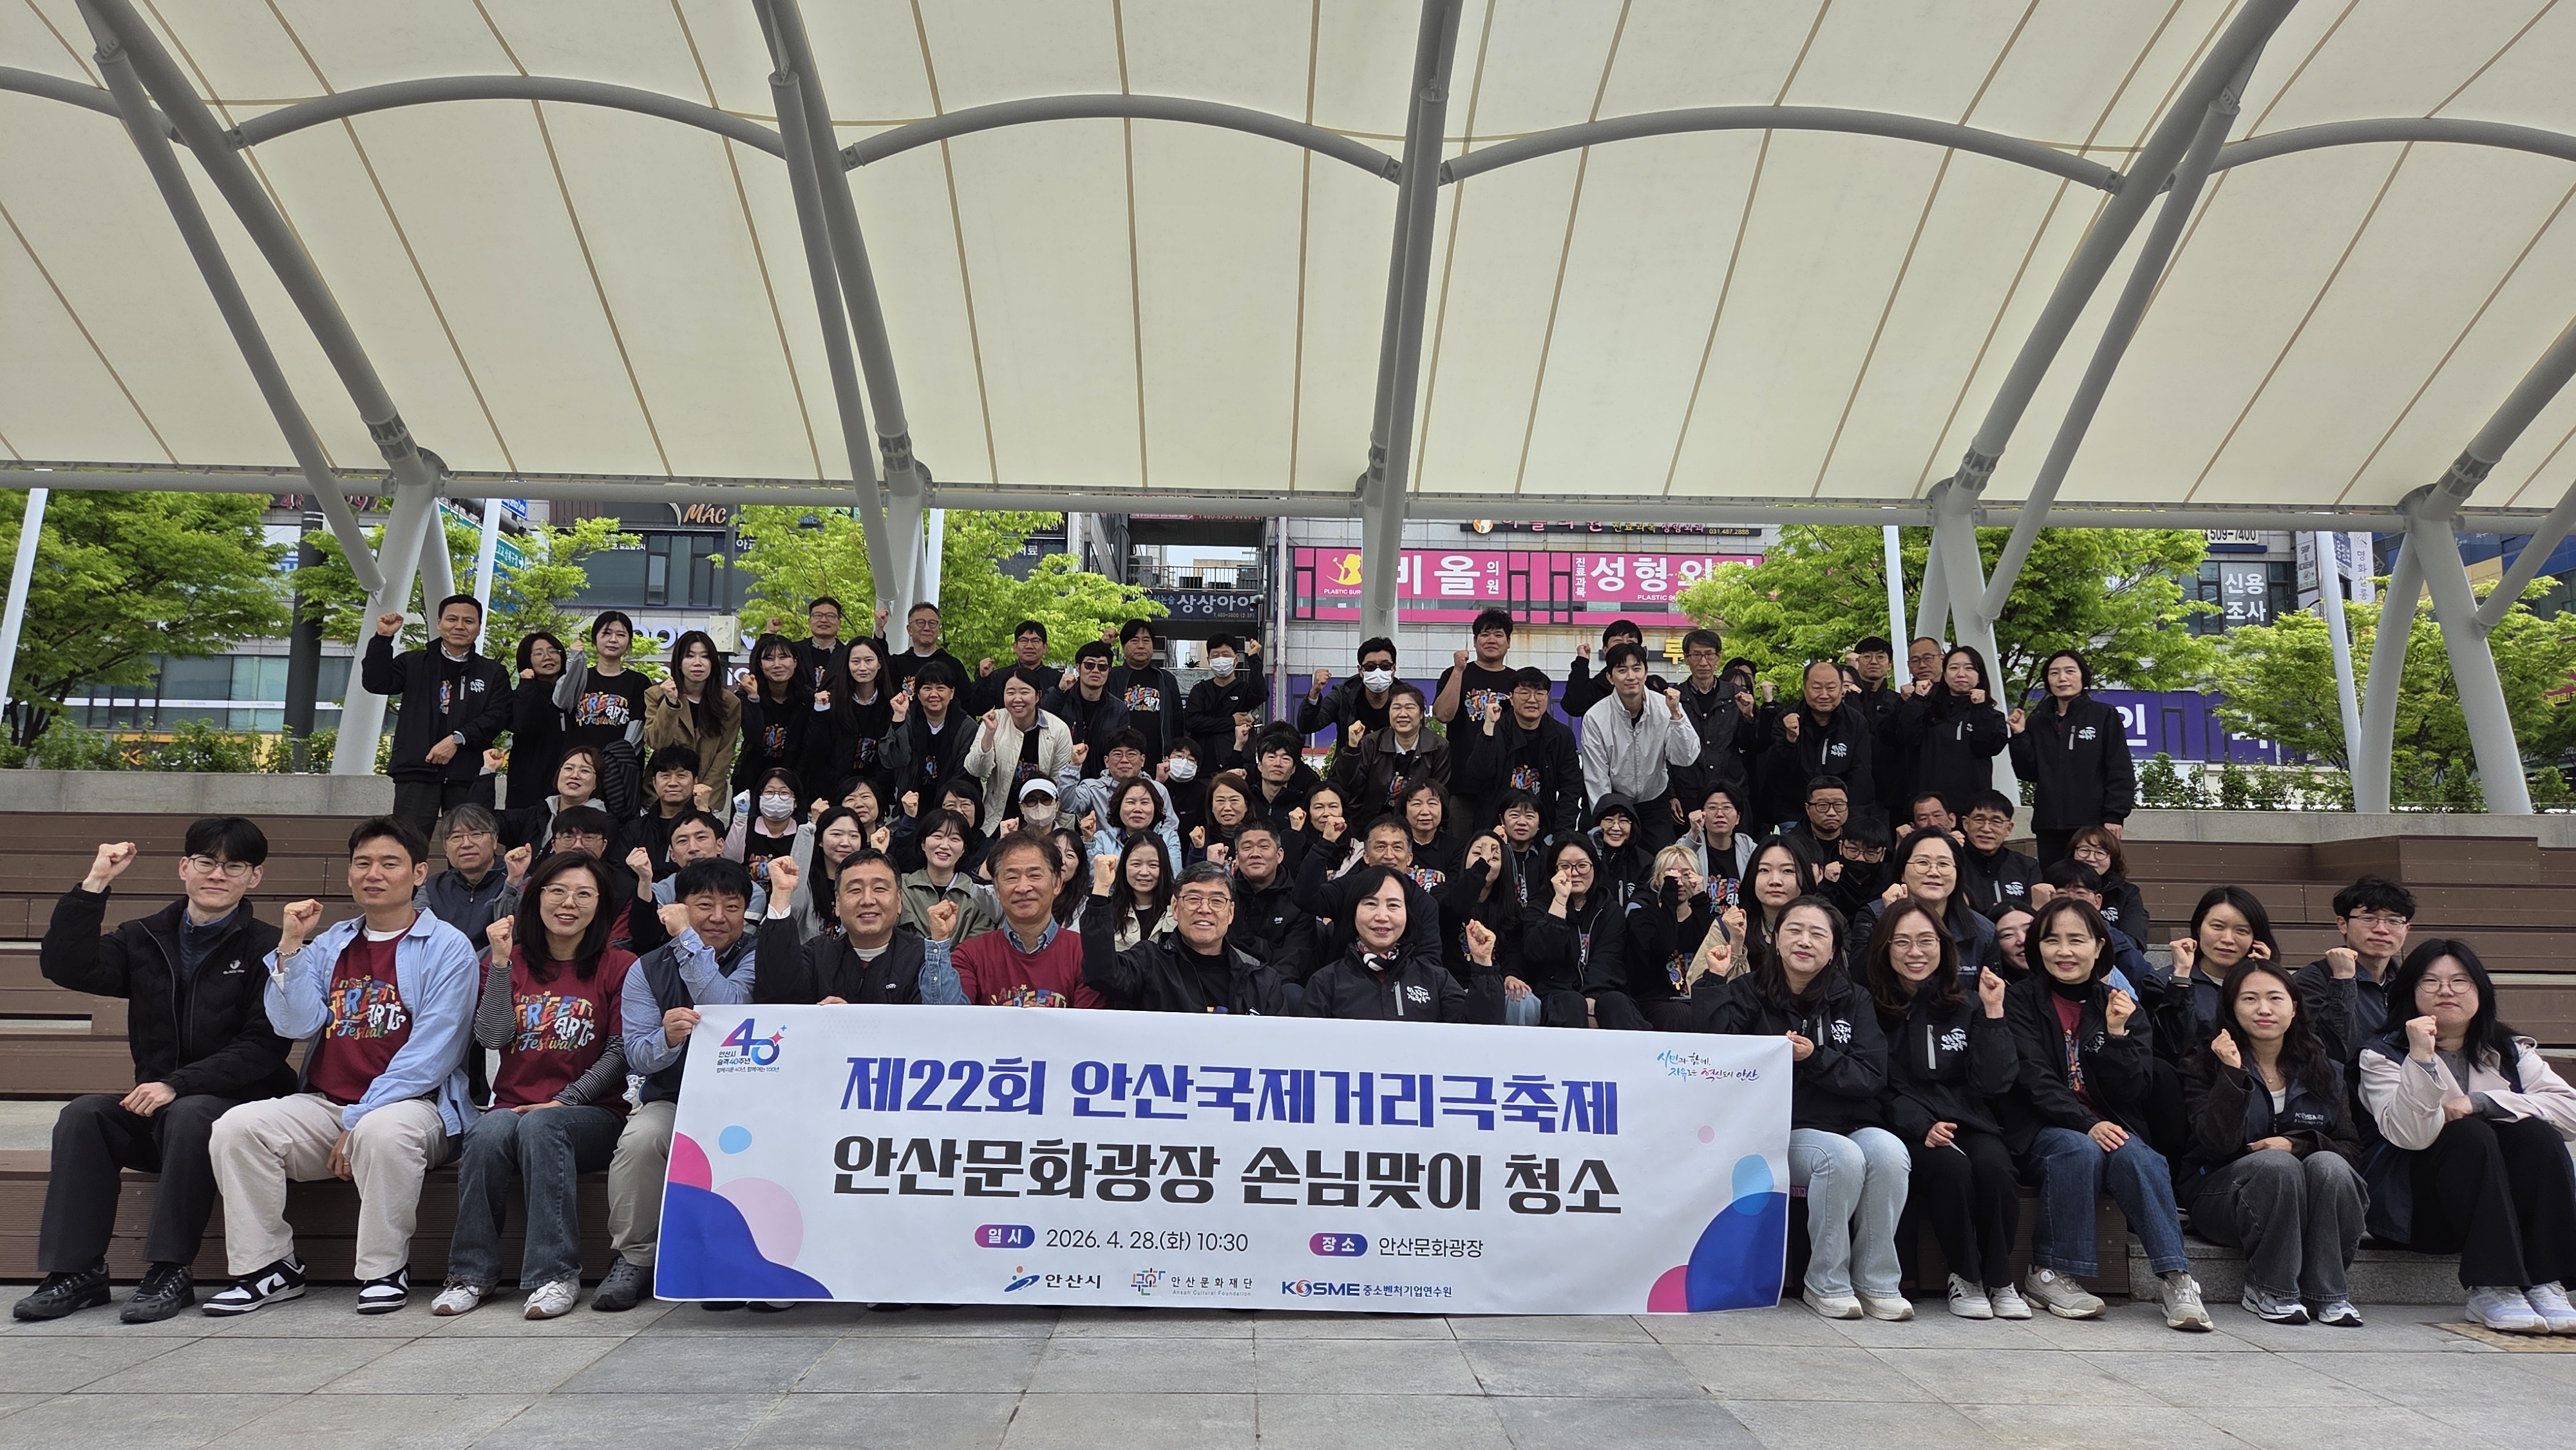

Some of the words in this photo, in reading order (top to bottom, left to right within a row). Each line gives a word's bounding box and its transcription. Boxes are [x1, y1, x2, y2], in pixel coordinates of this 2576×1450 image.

[1486, 560, 1500, 595] 의원
[1575, 557, 1586, 598] 진료과목
[1590, 556, 1754, 592] 성형외
[2224, 572, 2265, 595] 신용
[2226, 600, 2266, 621] 조사
[1701, 1068, 1734, 1083] 혁신도시
[1736, 1069, 1760, 1081] 안산
[840, 1057, 1046, 1115] 제22회
[1071, 1060, 1619, 1135] 안산국제거리극축제
[833, 1136, 1220, 1204] 안산문화광장
[1240, 1146, 1482, 1210] 손님맞이
[1504, 1153, 1622, 1215] 청소
[1046, 1229, 1101, 1248] 2026.
[1106, 1230, 1124, 1249] 4.
[1197, 1232, 1249, 1252] 10:30
[1379, 1238, 1484, 1258] 안산문화광장
[1045, 1274, 1101, 1290] 안산시
[1282, 1279, 1360, 1297] KOSME
[1363, 1285, 1453, 1298] 중소벤처기업연수원
